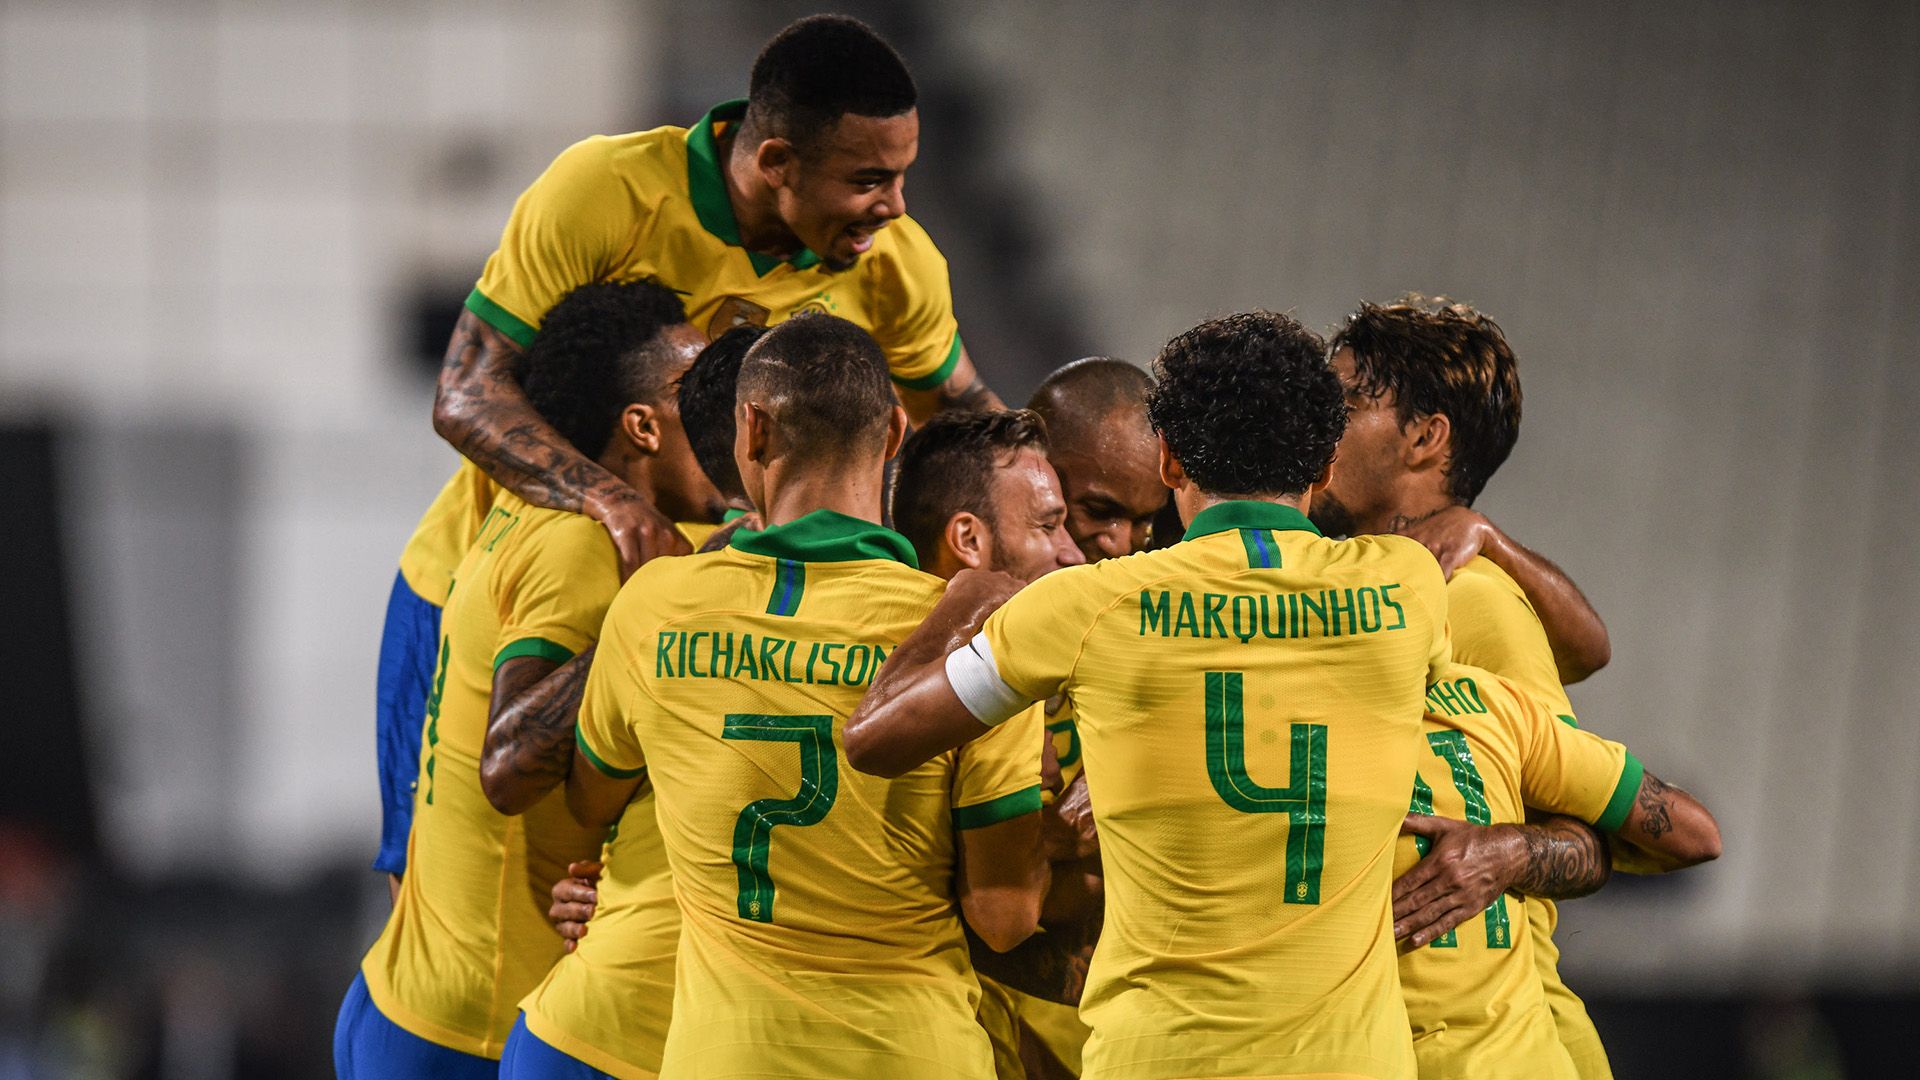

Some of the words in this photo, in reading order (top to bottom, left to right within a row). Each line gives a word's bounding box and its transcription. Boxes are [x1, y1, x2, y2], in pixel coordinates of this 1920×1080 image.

[1139, 583, 1406, 643] MARQUINHOS
[721, 713, 838, 922] 7
[1204, 671, 1328, 905] 4
